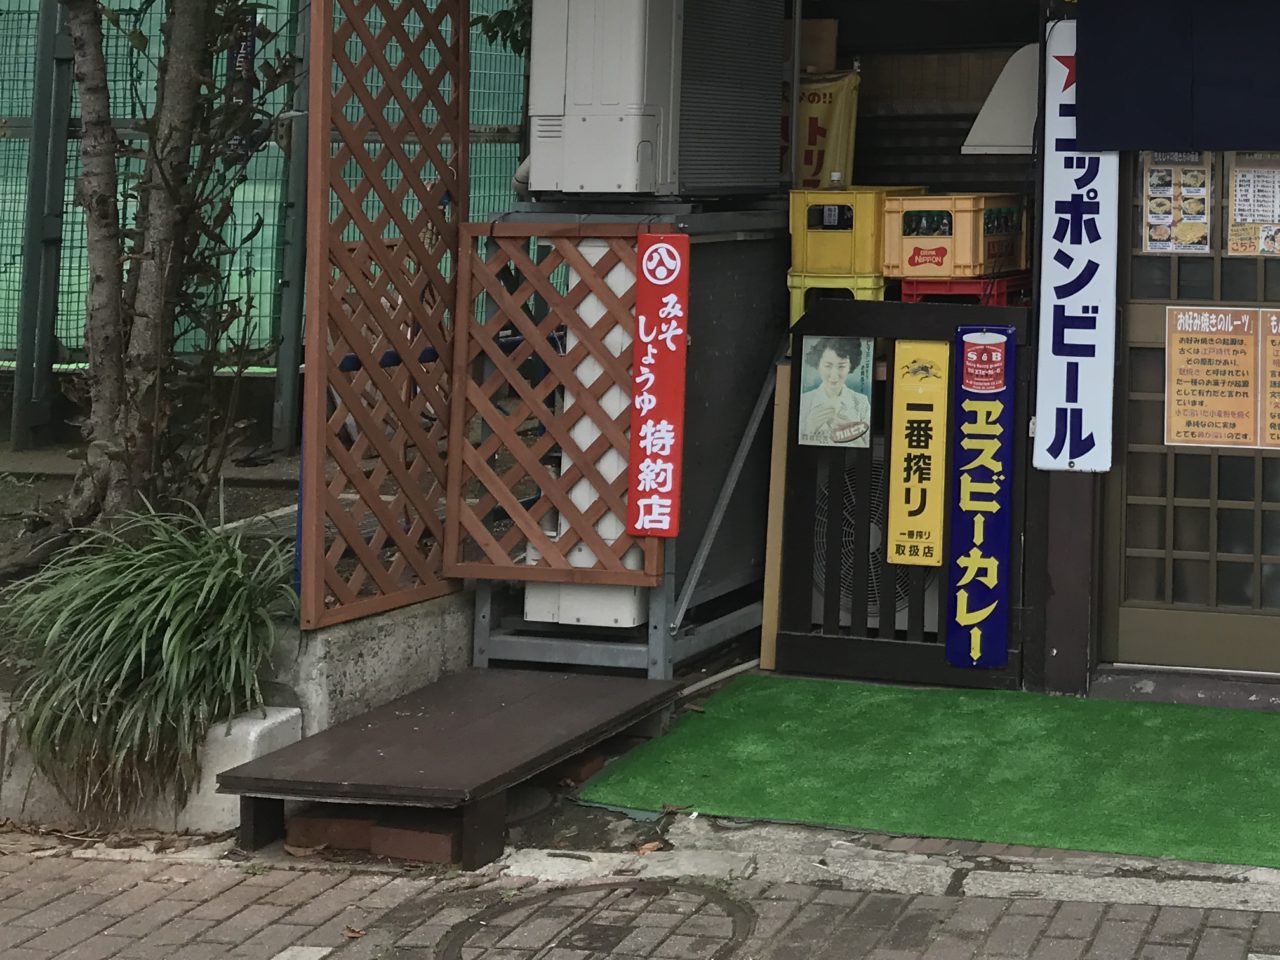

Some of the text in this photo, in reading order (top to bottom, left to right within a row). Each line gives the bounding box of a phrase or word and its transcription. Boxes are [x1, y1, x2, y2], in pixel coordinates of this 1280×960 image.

[1231, 241, 1257, 252] こちら
[658, 293, 684, 352] みそ
[635, 315, 657, 417] しょうゆ
[634, 419, 675, 530] 特約店
[902, 402, 934, 518] 一番搾り
[895, 543, 934, 557] 取扱店
[899, 530, 931, 540] 一番搾り
